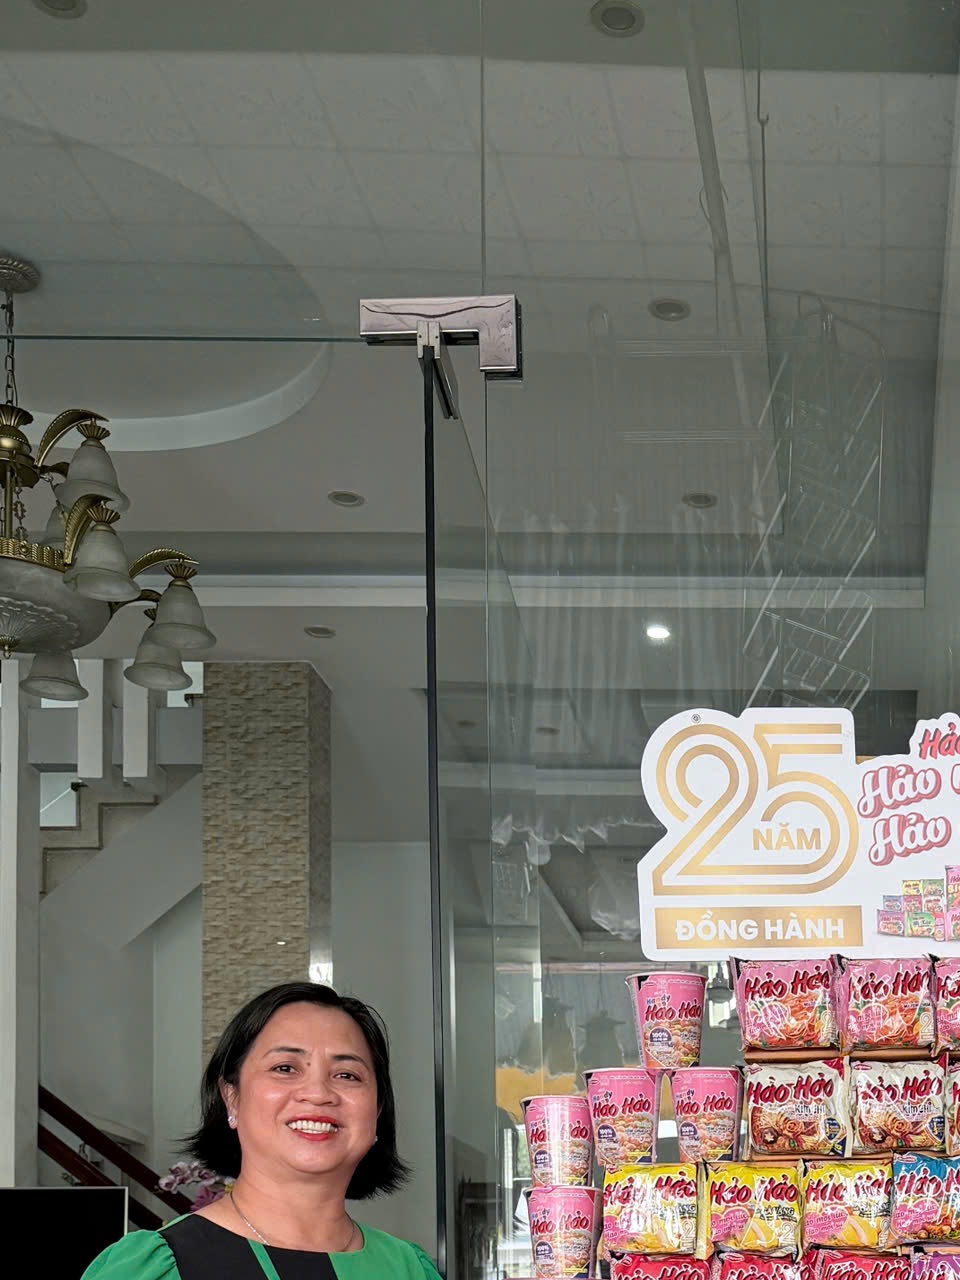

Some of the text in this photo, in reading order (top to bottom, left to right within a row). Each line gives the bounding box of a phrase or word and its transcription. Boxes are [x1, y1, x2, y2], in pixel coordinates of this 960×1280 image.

[652, 723, 859, 896] 25
[858, 764, 942, 818] Hảo
[752, 822, 822, 851] NĂM
[868, 815, 951, 866] Hảo
[675, 909, 845, 942] ĐỒNG HÀNH
[748, 1073, 834, 1103] Hảo Hảo
